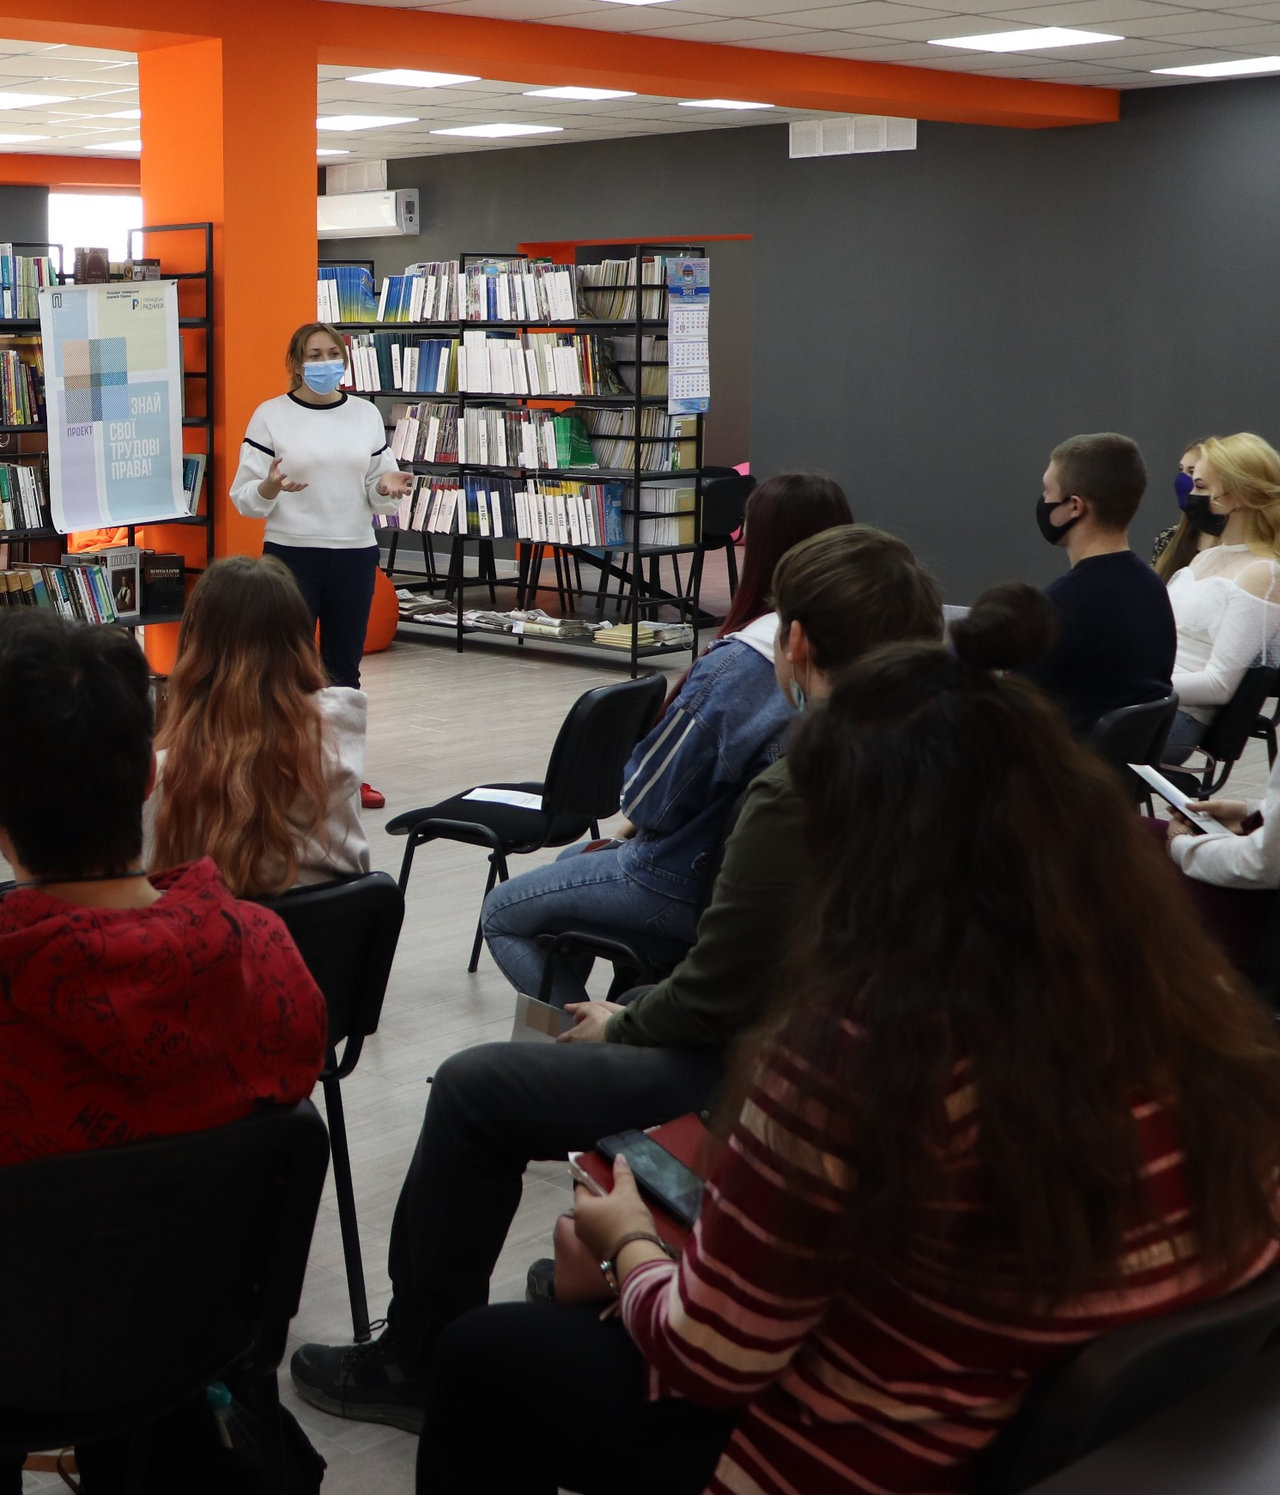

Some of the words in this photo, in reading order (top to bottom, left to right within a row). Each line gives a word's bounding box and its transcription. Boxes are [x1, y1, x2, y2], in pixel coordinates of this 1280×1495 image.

[131, 392, 161, 414] ЗНАЙ
[67, 426, 93, 437] ПРОЕКТ
[109, 418, 136, 440] СВОЇ
[110, 438, 160, 460] ТРУДОВІ
[111, 458, 152, 480] ПРАВА!
